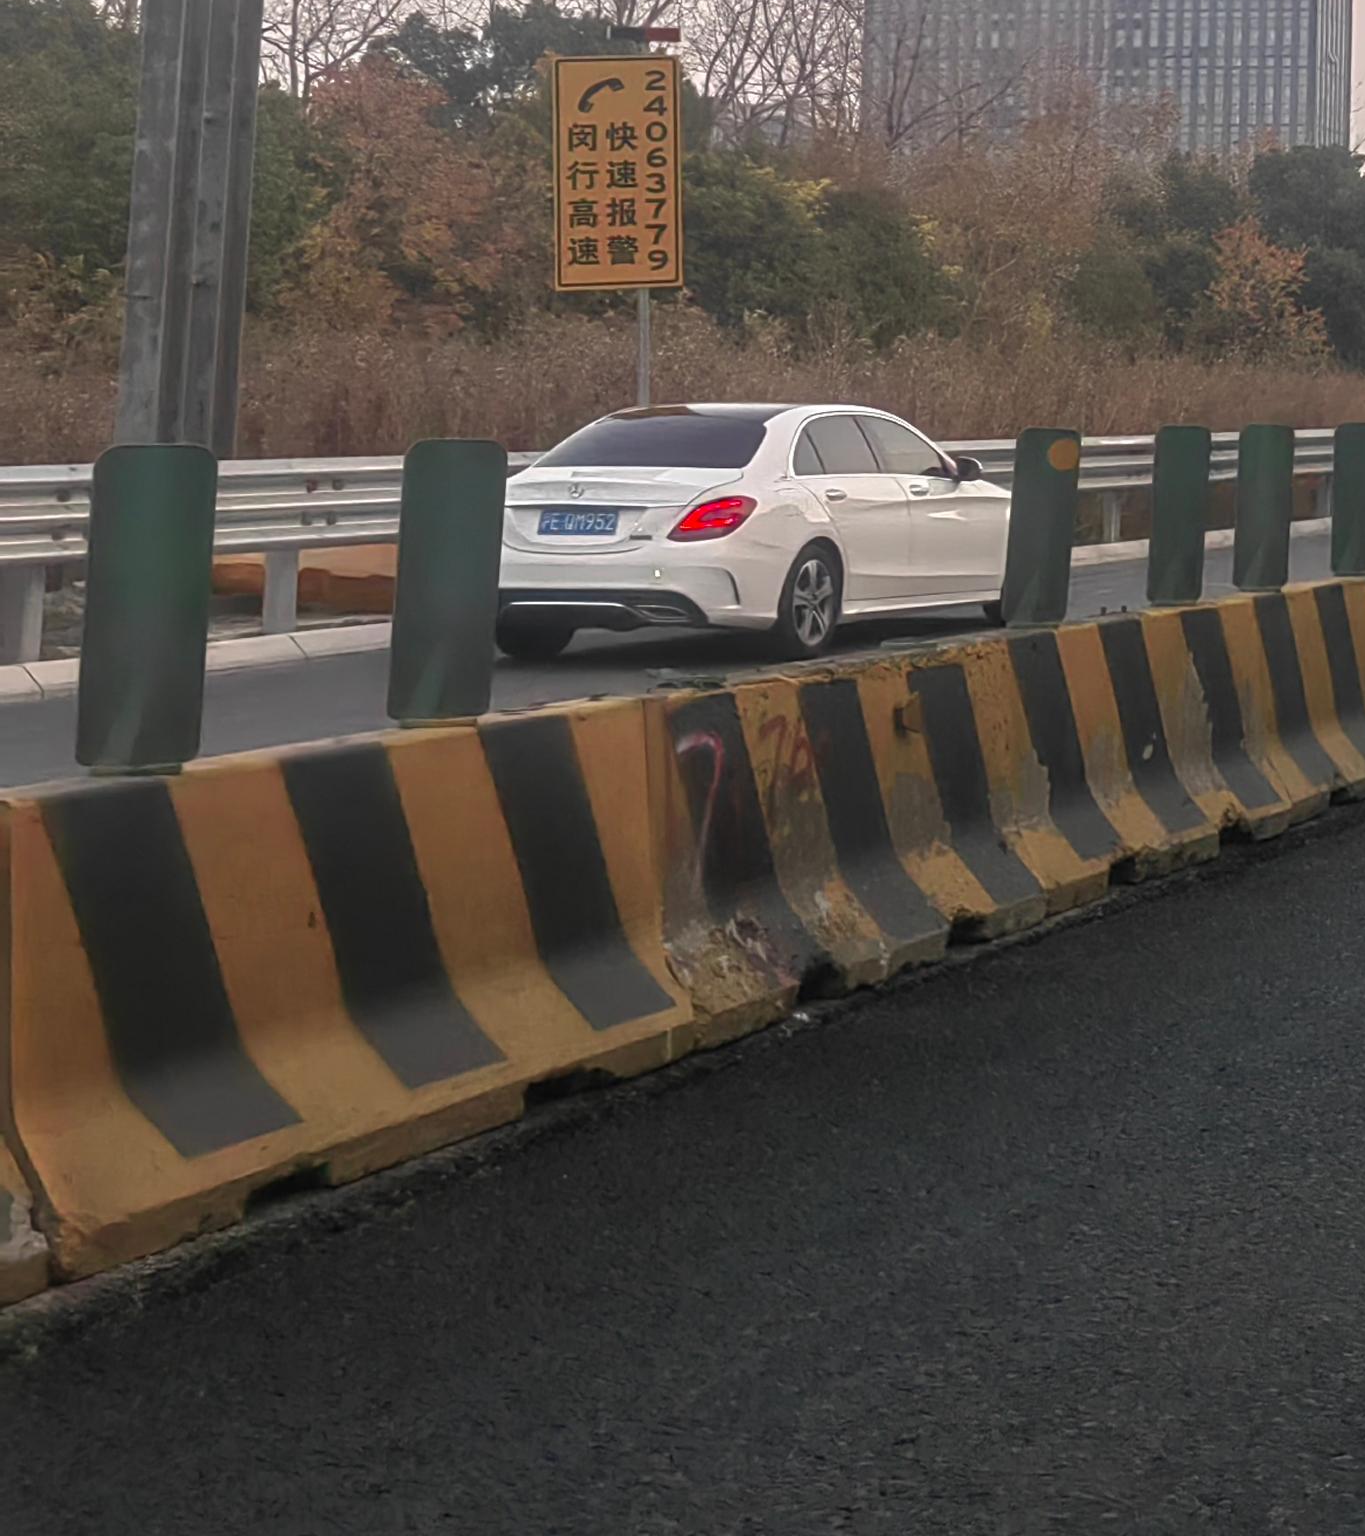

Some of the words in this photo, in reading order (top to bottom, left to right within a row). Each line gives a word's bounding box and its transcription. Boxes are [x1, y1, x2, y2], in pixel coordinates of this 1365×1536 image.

[565, 123, 601, 266] 闵行高速
[605, 121, 639, 266] 快速报警
[643, 70, 669, 271] 24063779
